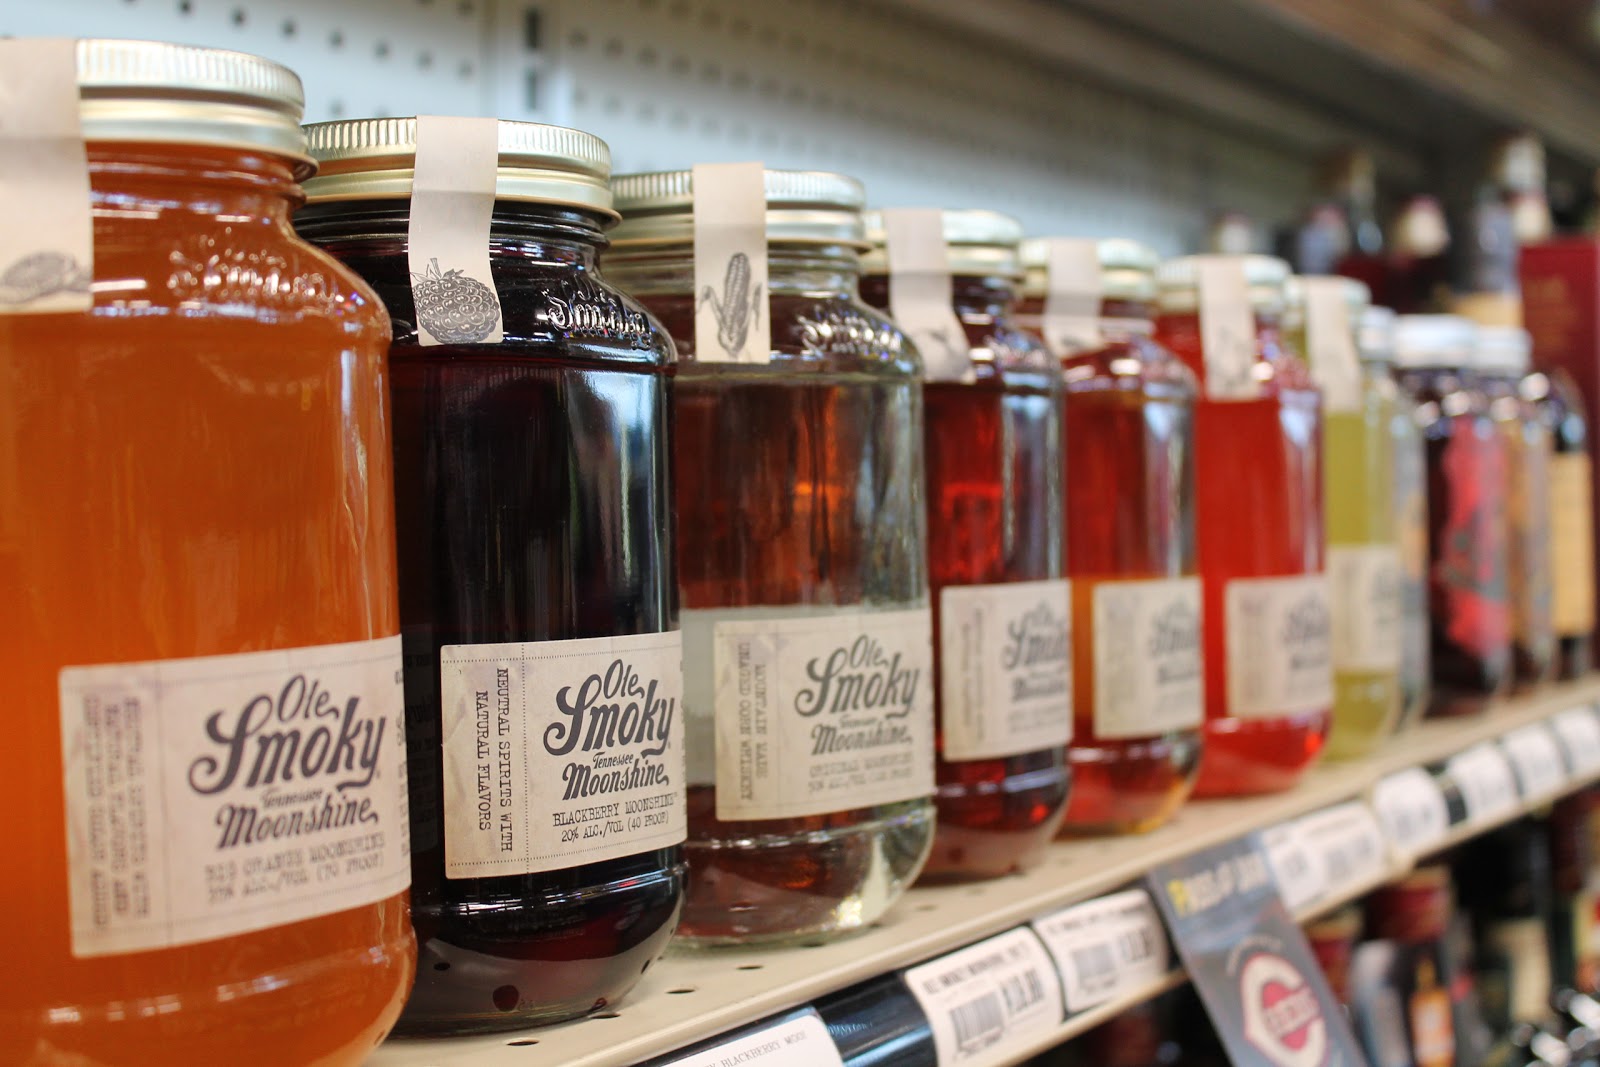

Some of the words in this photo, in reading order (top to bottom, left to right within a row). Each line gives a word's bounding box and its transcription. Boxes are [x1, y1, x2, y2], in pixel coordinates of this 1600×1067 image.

[851, 634, 889, 668] Ole
[277, 674, 340, 723] Ole
[497, 668, 510, 736] NEUTRAL
[602, 658, 645, 699] Ole
[794, 648, 920, 719] Smoky
[476, 690, 489, 759] NATURAL
[543, 673, 676, 760] Smoky
[188, 693, 386, 796] Smoky
[593, 752, 634, 769] Tennessee
[477, 764, 492, 831] FLAVORS
[499, 742, 512, 808] SPIRITS
[562, 757, 670, 801] Moonshine
[215, 792, 380, 851] Moonshine
[500, 812, 513, 852] WITH
[552, 802, 620, 827] BLACKBERRY
[561, 827, 579, 843] 20%
[627, 816, 641, 832] (40
[644, 810, 669, 827] PROOF)
